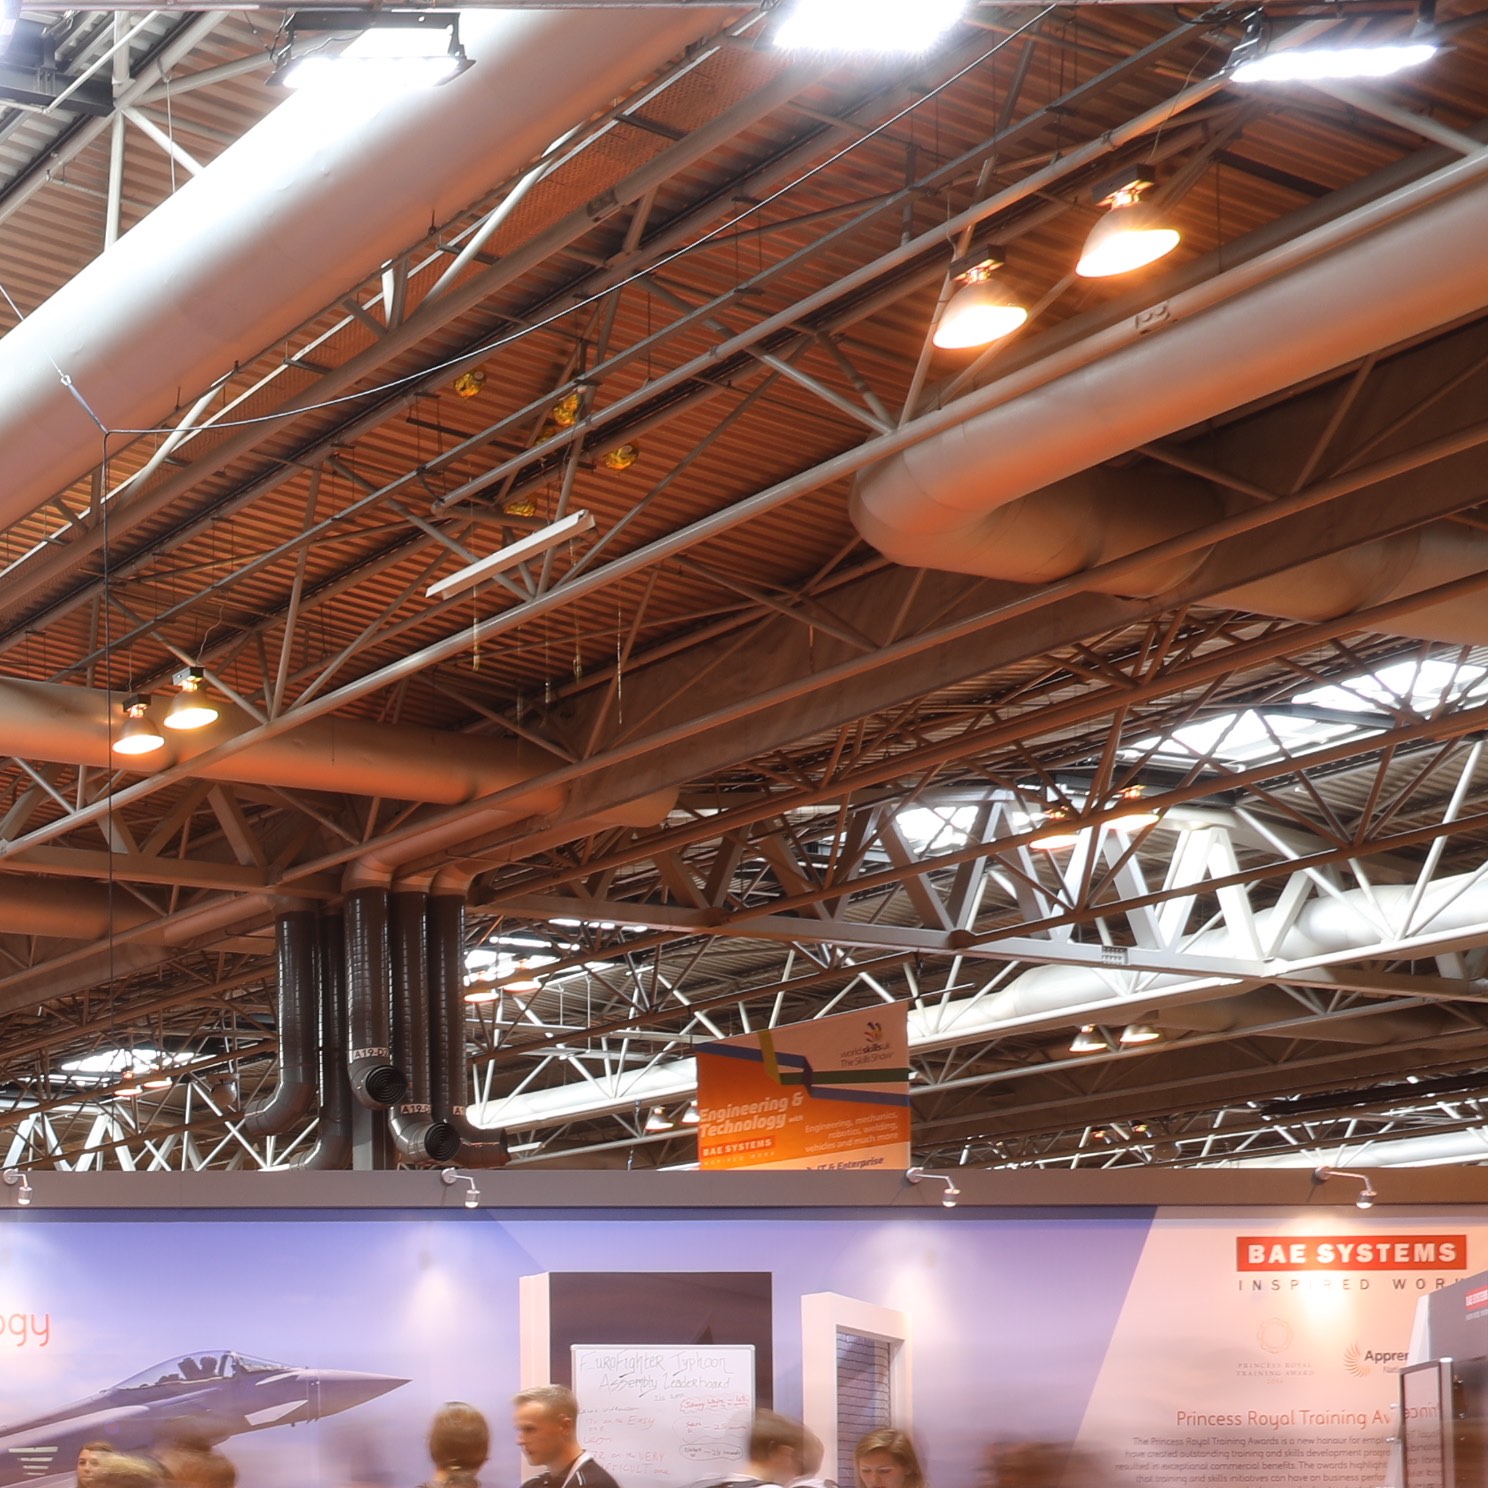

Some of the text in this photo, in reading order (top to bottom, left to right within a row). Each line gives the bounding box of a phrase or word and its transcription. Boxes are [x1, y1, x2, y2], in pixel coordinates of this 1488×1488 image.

[699, 1091, 803, 1123] Engineering &
[699, 1114, 786, 1138] Technology
[853, 1135, 875, 1144] much
[877, 1132, 898, 1141] more
[703, 1139, 772, 1157] BAE SYSTEMS
[837, 1157, 884, 1170] Enterprise
[1248, 1243, 1456, 1264] BAE SYSTEMS
[1177, 1410, 1367, 1430] Princess Royal Training
[1185, 1437, 1210, 1448] Royal
[1212, 1437, 1246, 1448] Training
[1248, 1437, 1279, 1445] Awards
[1317, 1437, 1347, 1445] honour
[1349, 1437, 1360, 1445] for
[1179, 1450, 1229, 1460] outstanding
[1231, 1450, 1264, 1459] training
[1265, 1449, 1282, 1457] and
[1284, 1449, 1304, 1457] skills
[1306, 1449, 1362, 1459] development
[1210, 1462, 1260, 1470] commercial
[1298, 1461, 1315, 1470] The
[1317, 1462, 1347, 1470] awards
[1190, 1474, 1205, 1482] and
[1207, 1474, 1227, 1482] skills
[1287, 1474, 1308, 1482] have
[1323, 1474, 1359, 1482] business
